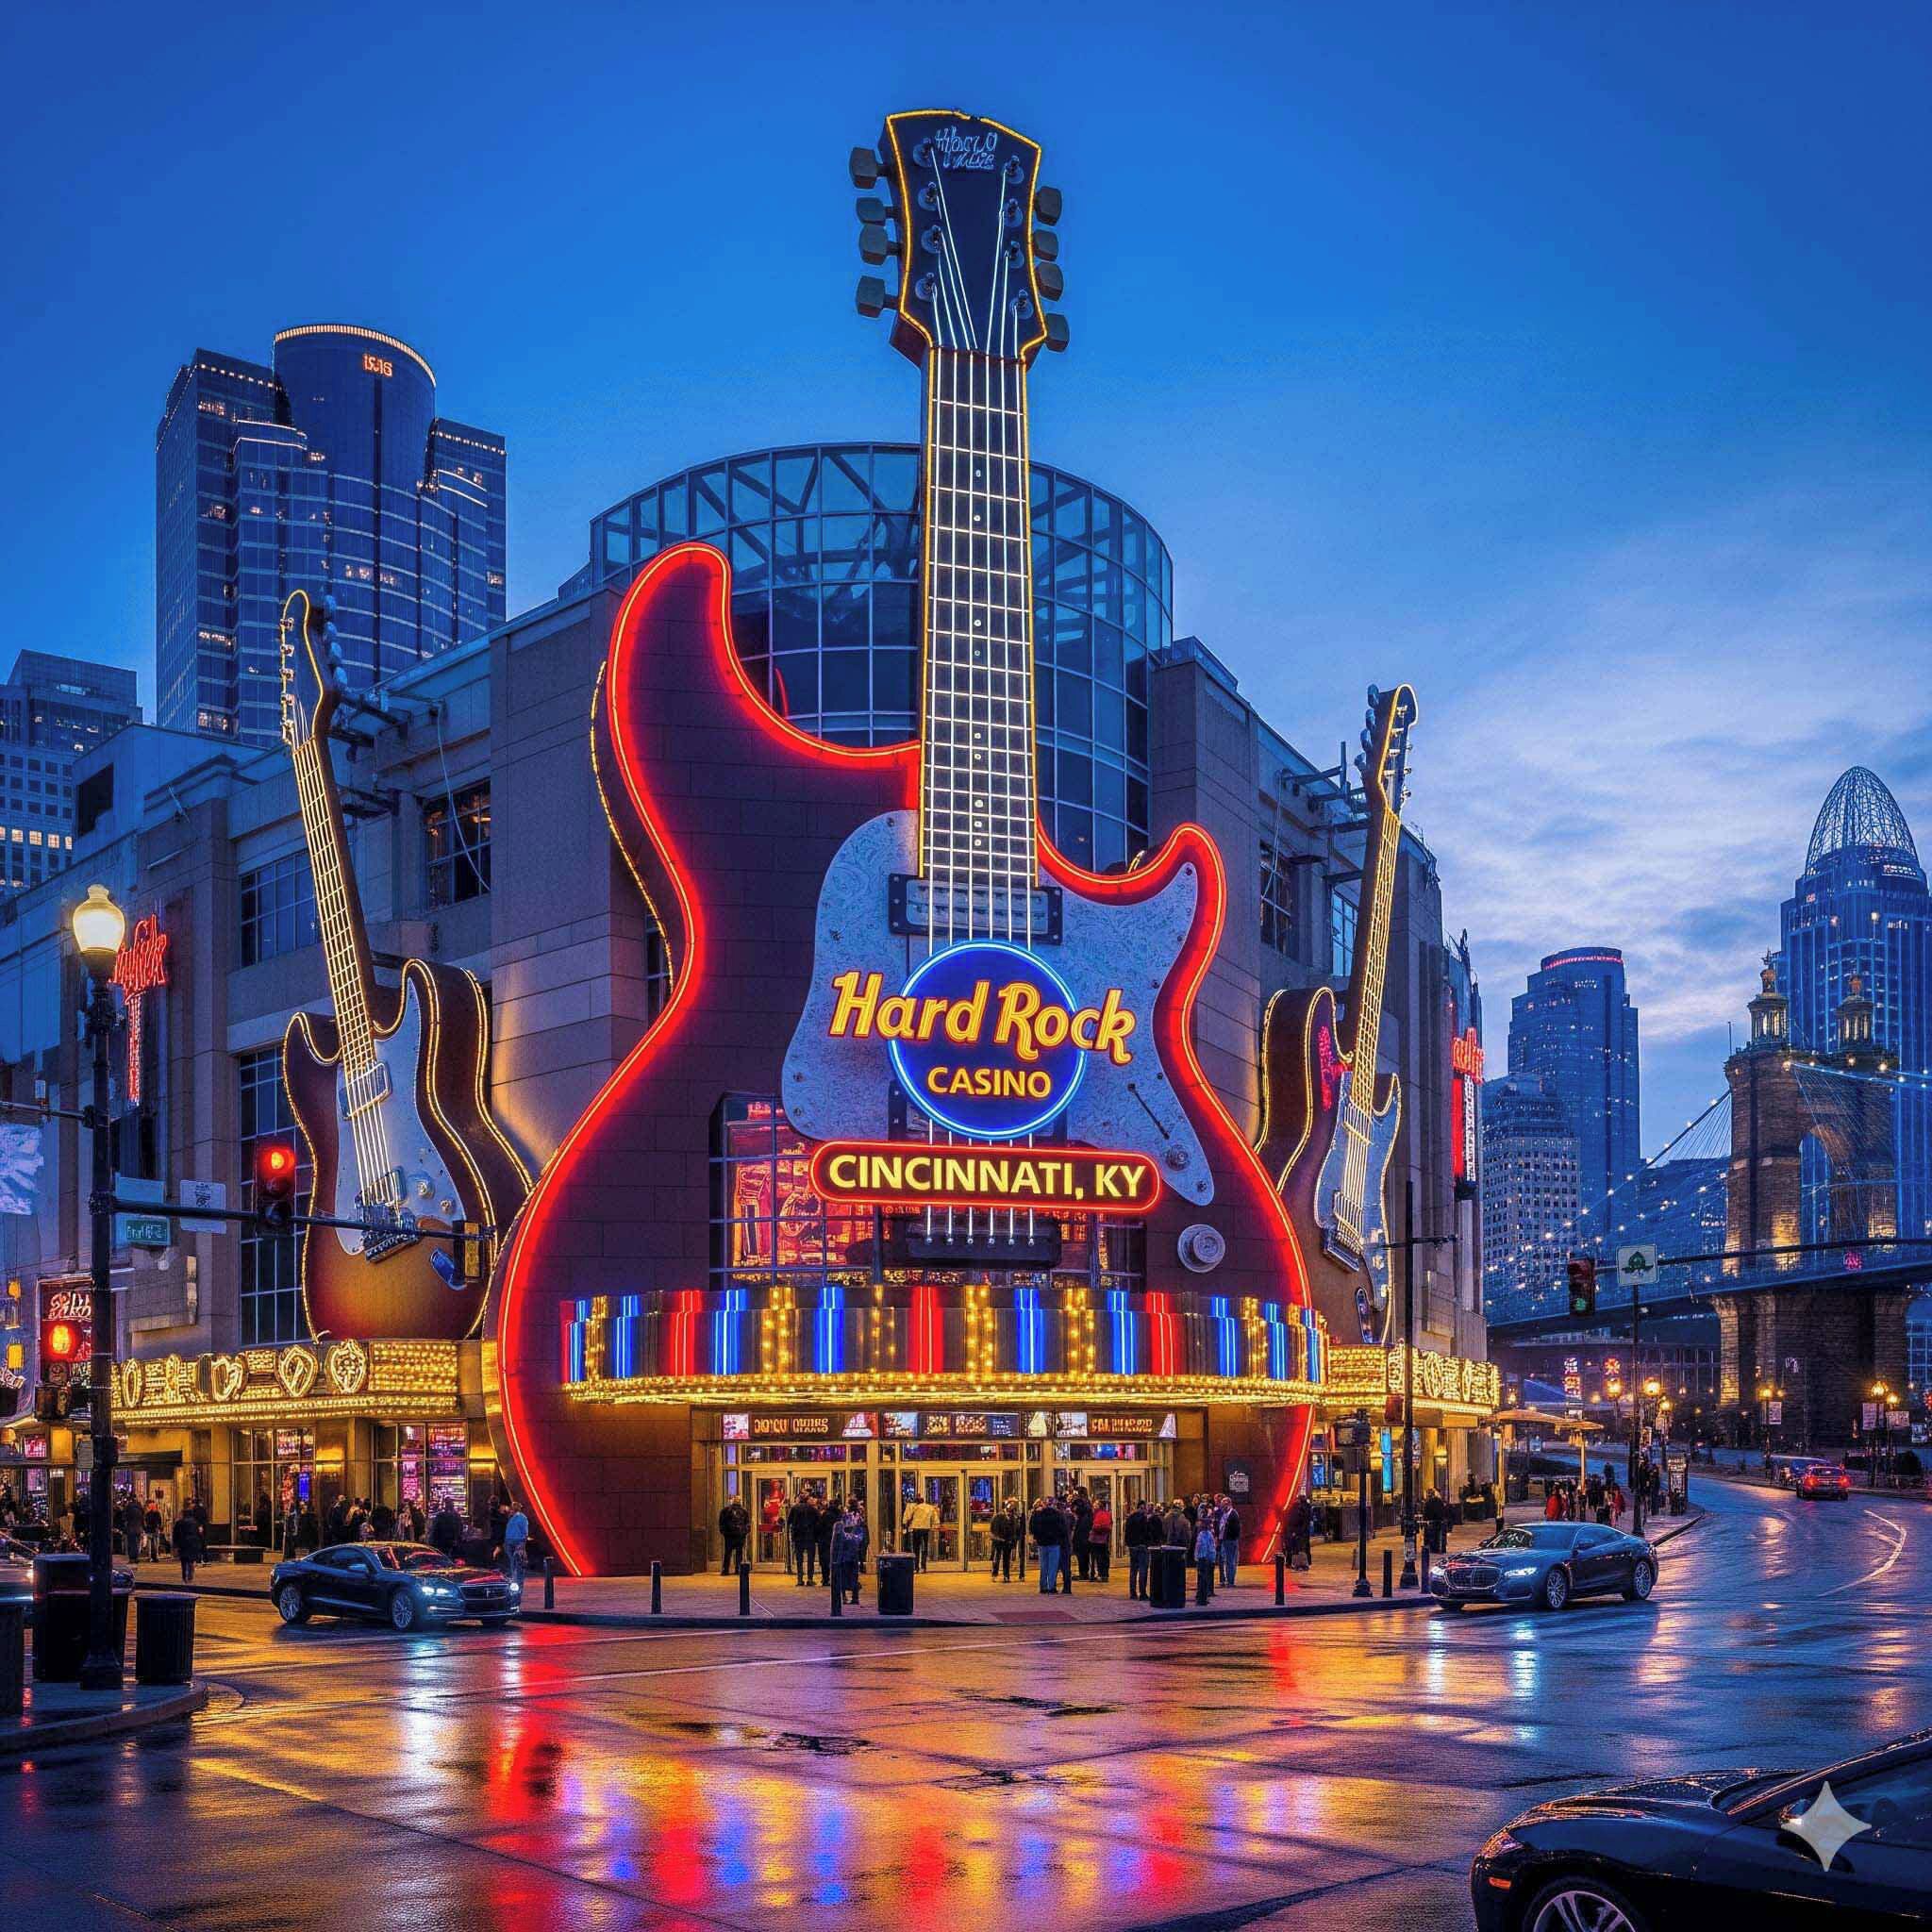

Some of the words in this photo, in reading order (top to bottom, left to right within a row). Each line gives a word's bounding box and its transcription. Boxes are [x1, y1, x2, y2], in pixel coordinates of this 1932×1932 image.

[829, 971, 990, 1042] Hard
[993, 981, 1137, 1065] Rock
[927, 1067, 1052, 1098] CASINO
[828, 1154, 1084, 1200] CINCINNATI,
[1094, 1164, 1146, 1197] KY
